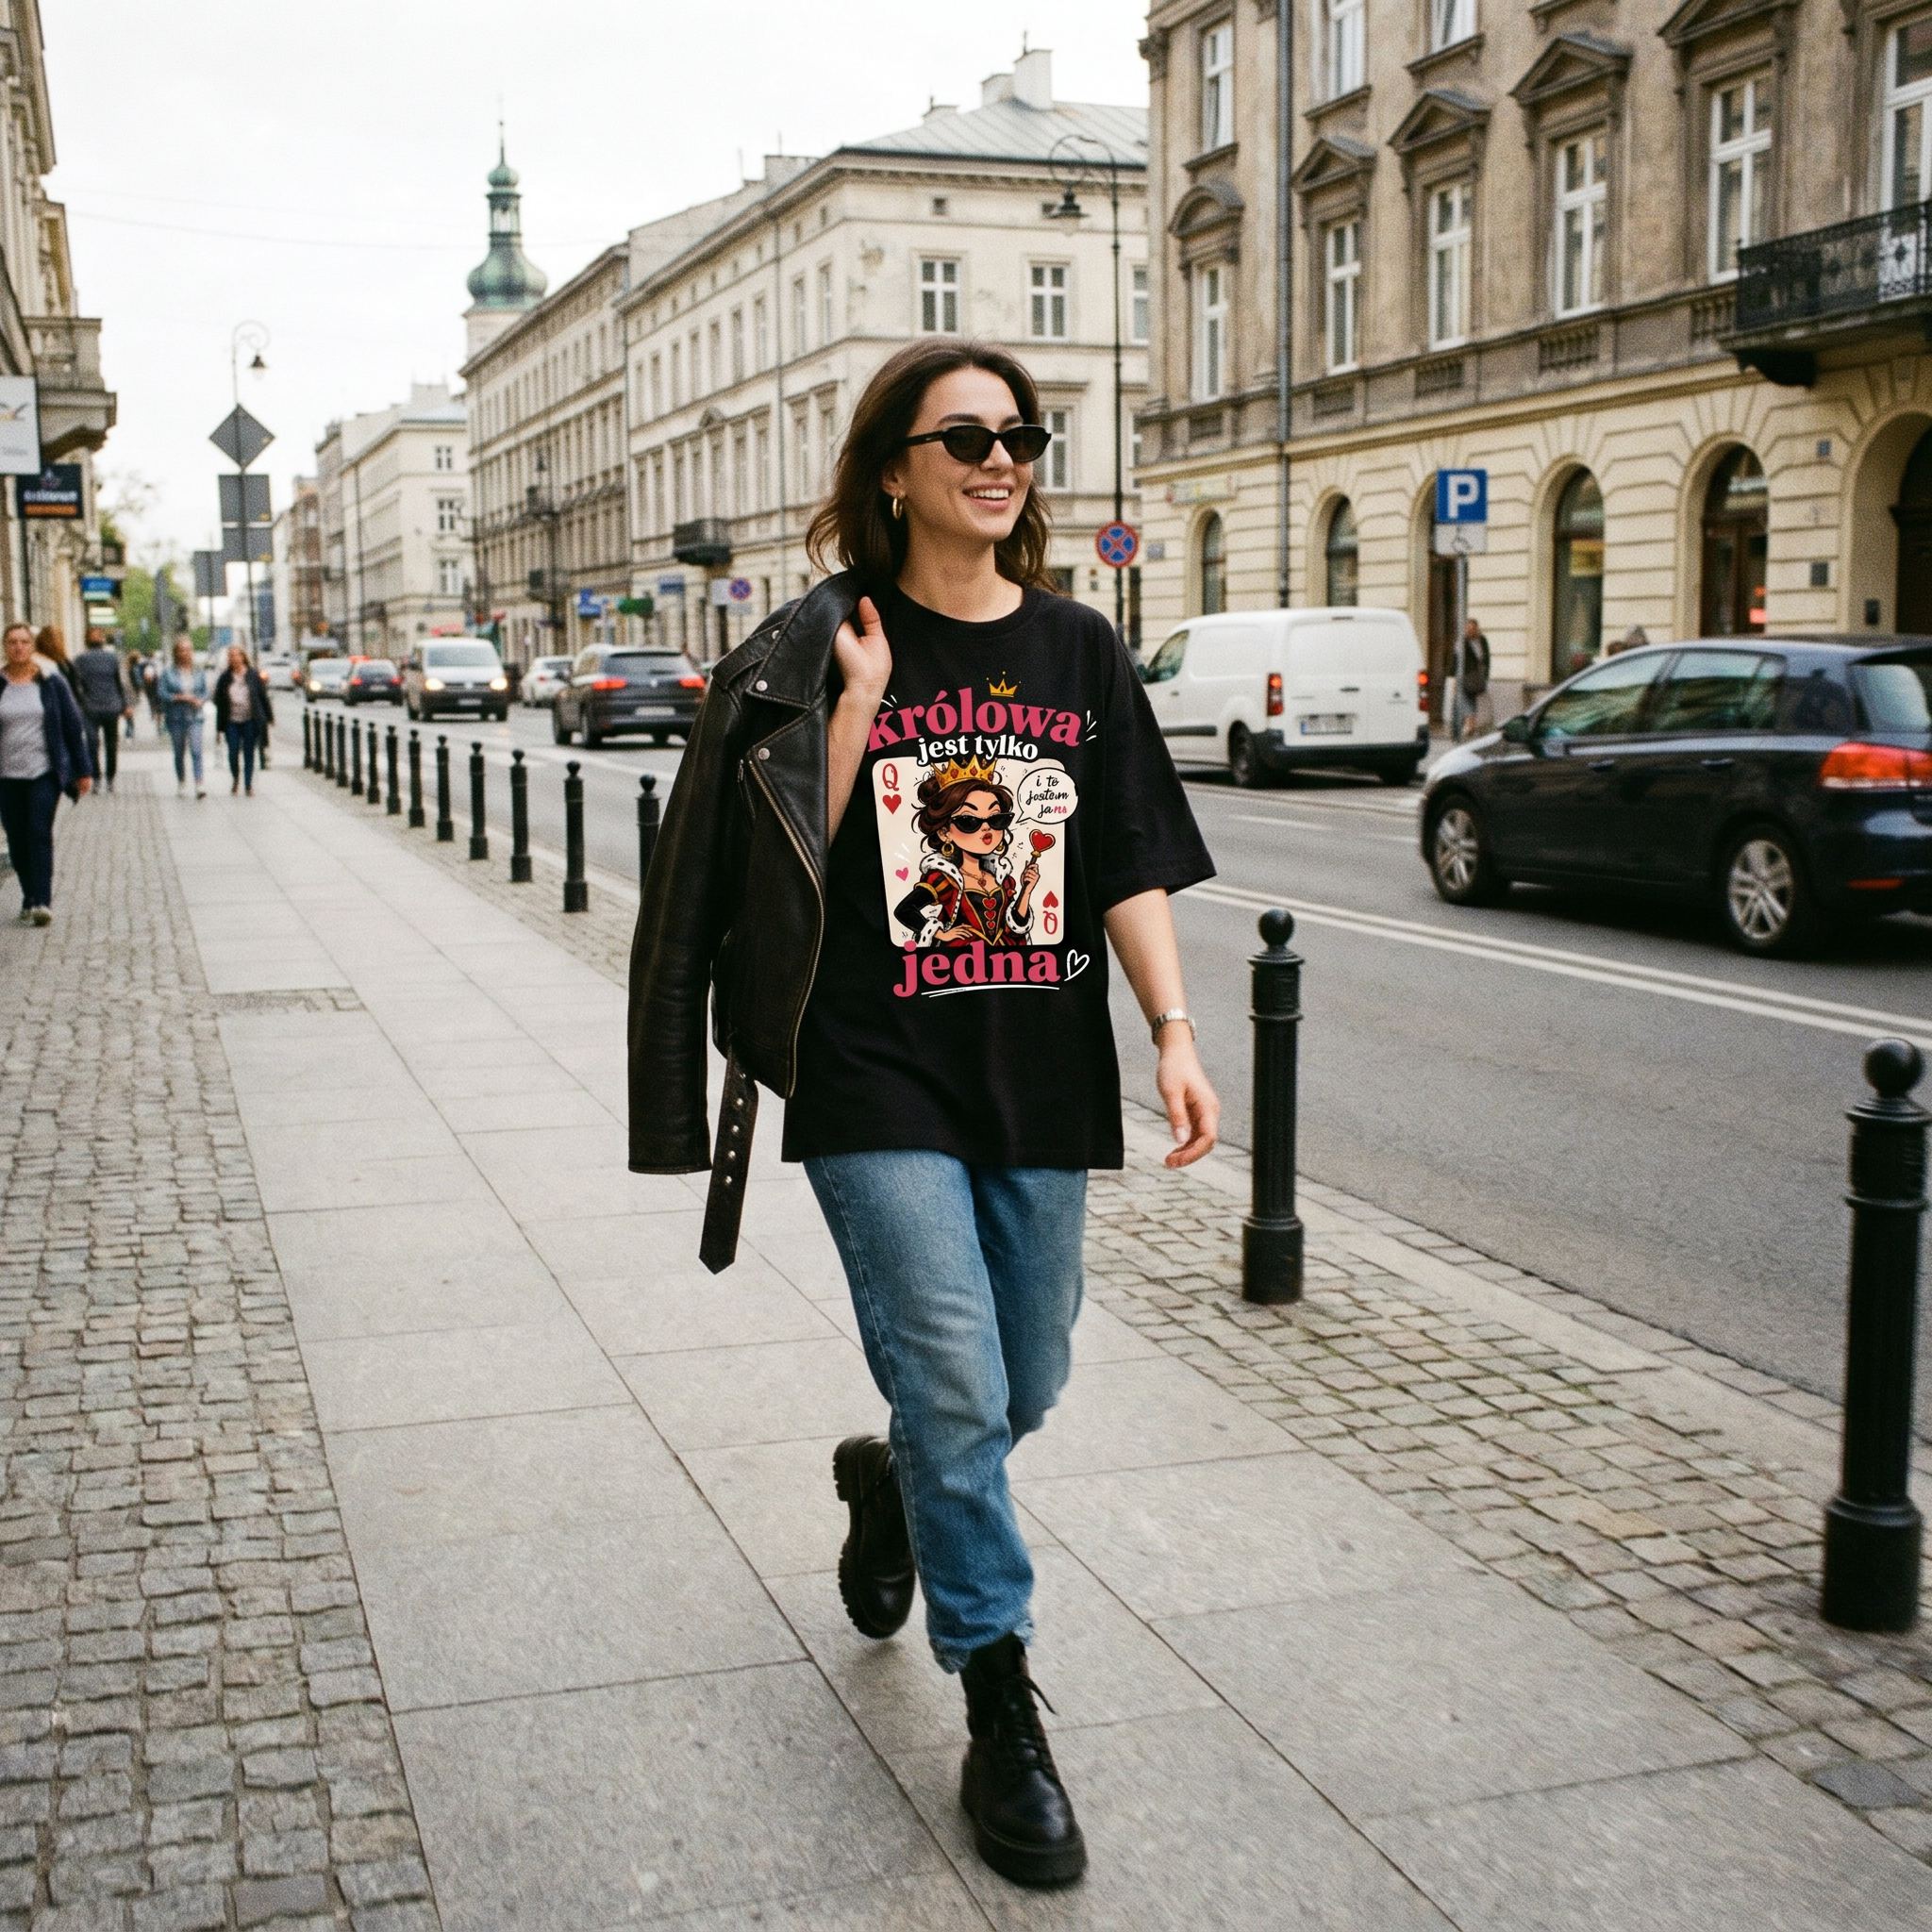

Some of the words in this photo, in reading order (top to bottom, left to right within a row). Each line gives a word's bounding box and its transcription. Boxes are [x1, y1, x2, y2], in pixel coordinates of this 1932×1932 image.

[1448, 474, 1479, 519] P
[868, 687, 1081, 752] królowa
[918, 736, 969, 765] jest
[975, 733, 1038, 760] tylko
[882, 763, 900, 791] Q
[1036, 775, 1041, 787] i
[1042, 910, 1058, 935] Q
[893, 940, 1060, 997] jedna
